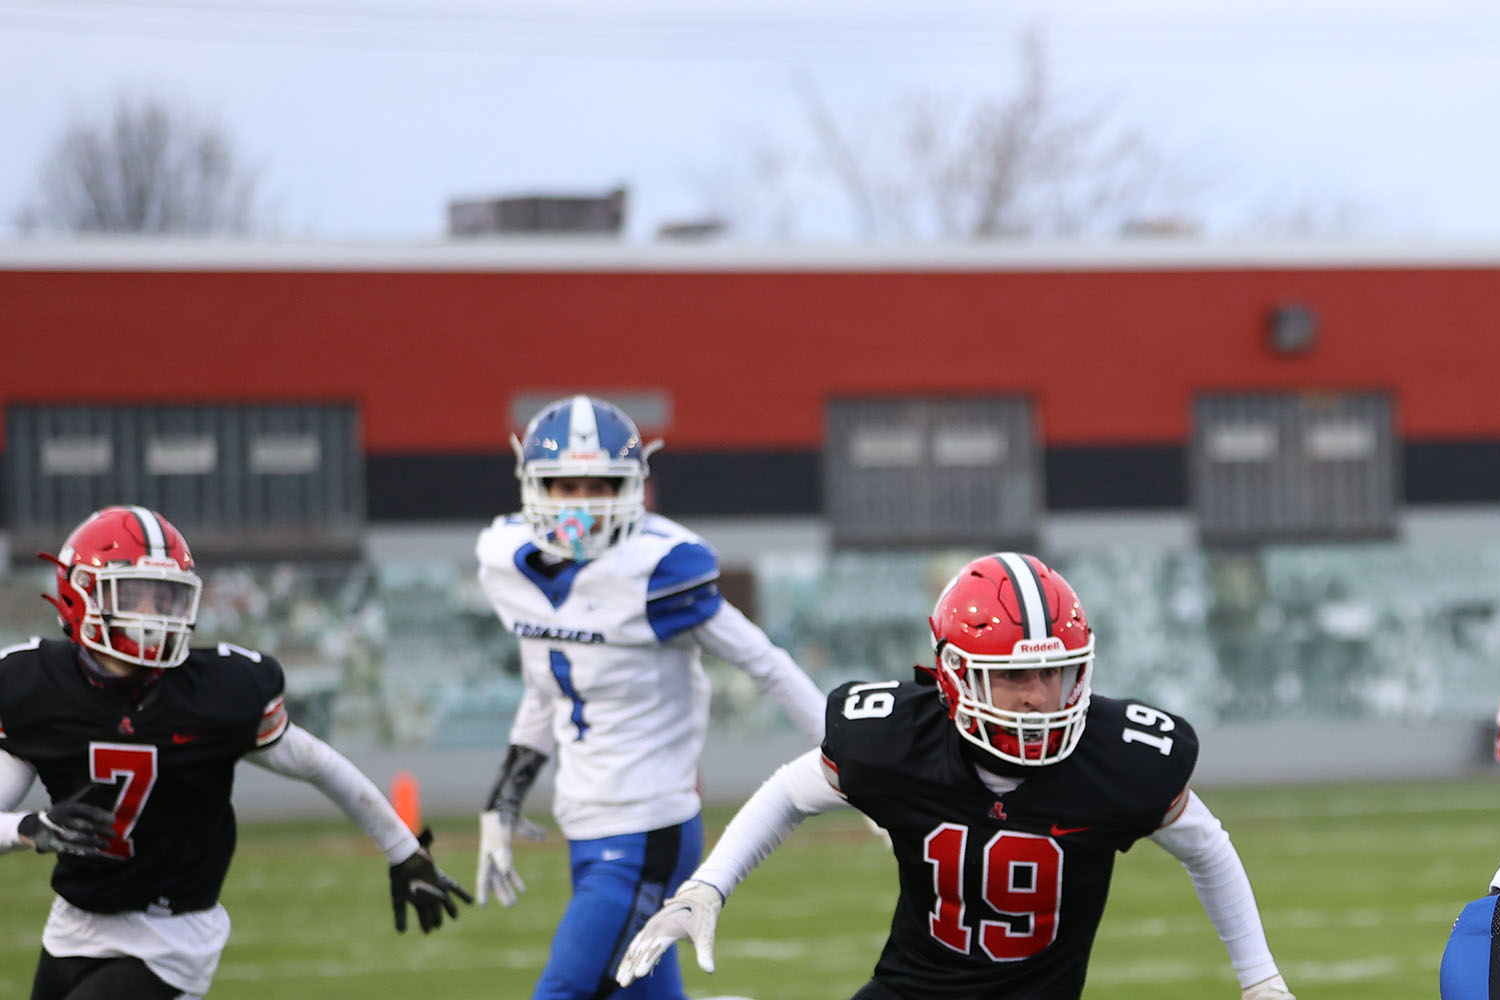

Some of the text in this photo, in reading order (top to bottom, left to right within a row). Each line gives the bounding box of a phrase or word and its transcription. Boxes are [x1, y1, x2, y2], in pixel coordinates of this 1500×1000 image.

[1020, 641, 1060, 653] Riddell
[549, 649, 591, 742] 1
[842, 680, 901, 720] 19
[1122, 703, 1176, 756] 19
[88, 741, 159, 861] 7
[924, 821, 1065, 963] 19
